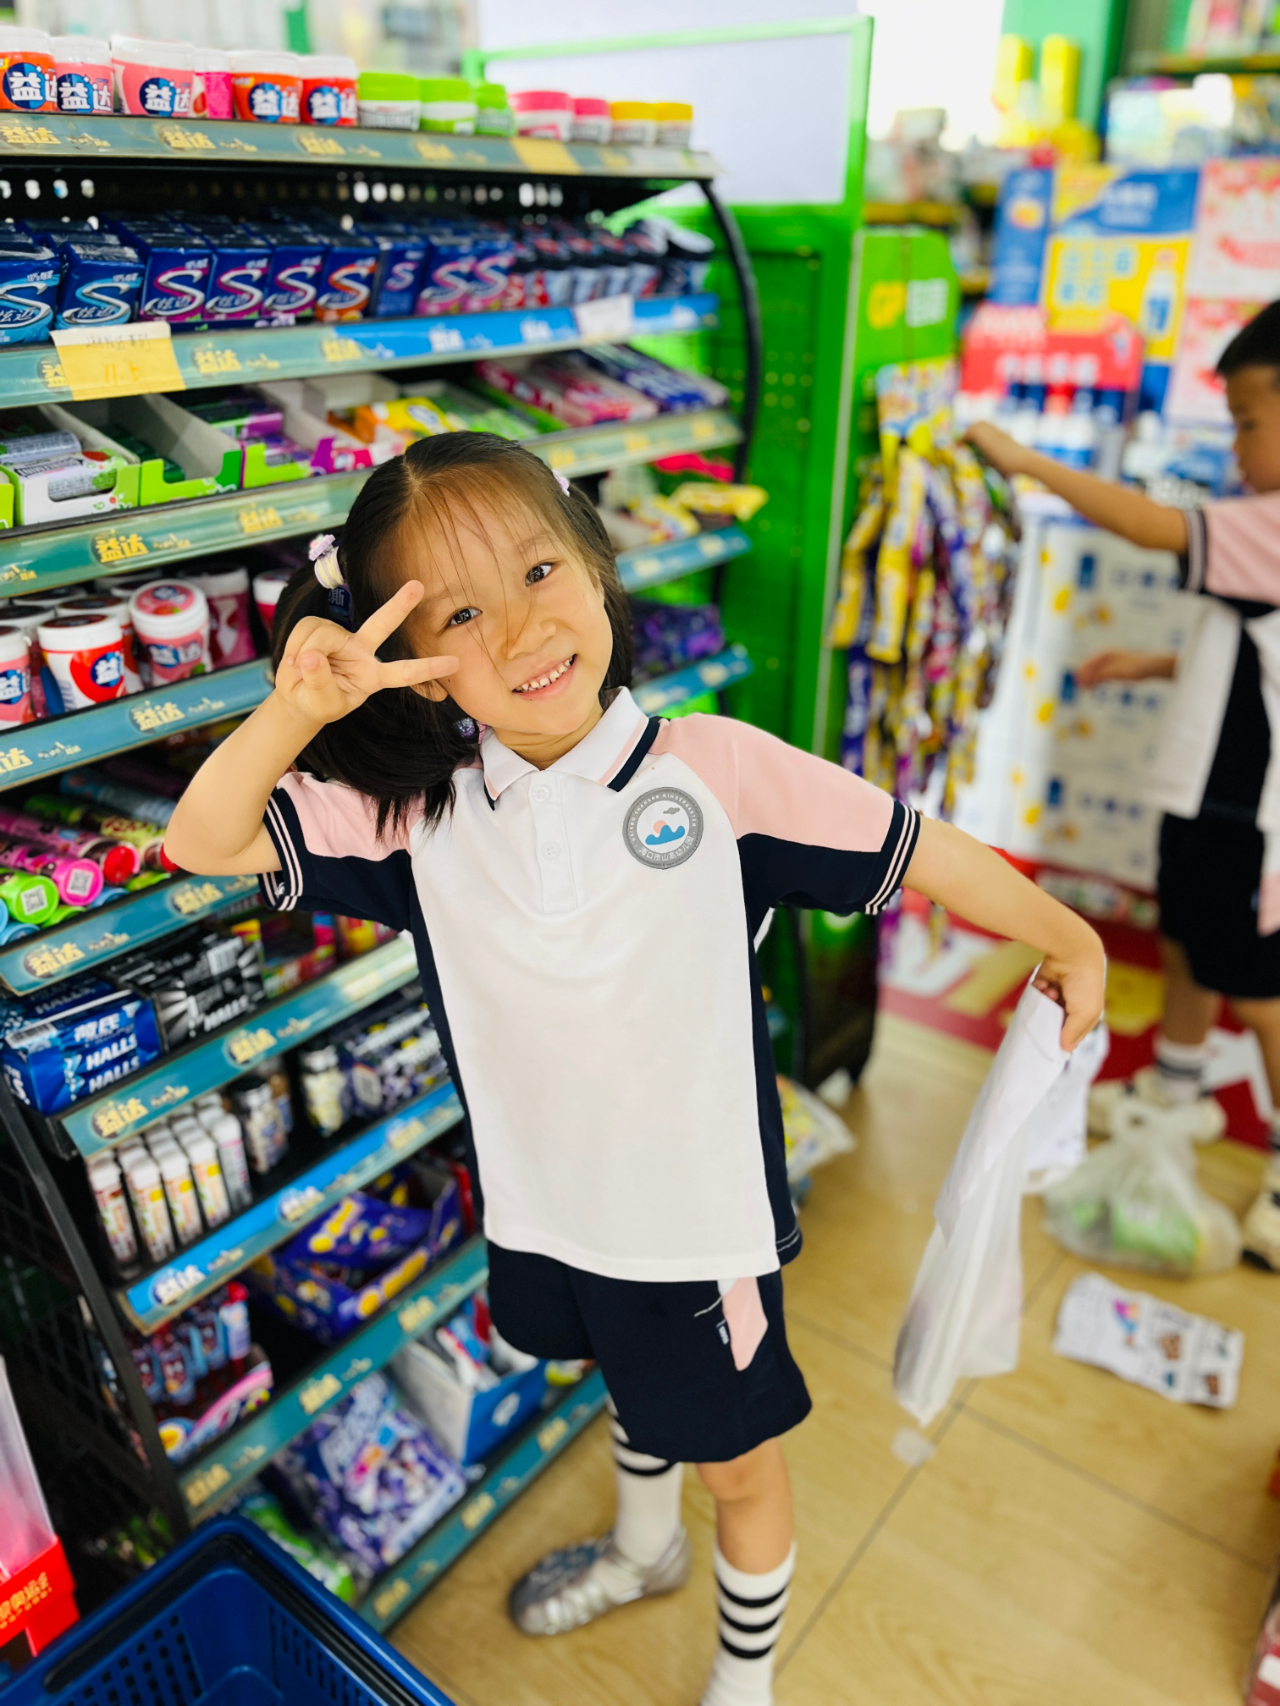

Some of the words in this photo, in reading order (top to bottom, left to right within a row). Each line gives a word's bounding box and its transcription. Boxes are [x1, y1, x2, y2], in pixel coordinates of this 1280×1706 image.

[59, 81, 112, 112] 益达
[145, 84, 191, 112] 益达
[251, 88, 299, 117] 益达
[1, 125, 61, 146] 益达
[163, 130, 216, 151] 益达
[77, 306, 115, 319] 炫迈
[197, 346, 241, 373] 益达
[97, 532, 148, 563] 益达
[95, 657, 124, 684] 益
[134, 702, 185, 731] 益达
[662, 793, 697, 827] KINDERGARTEN
[29, 942, 85, 977] 益达
[86, 1033, 138, 1071] HALLS
[88, 1055, 140, 1094] HALLS
[98, 1098, 148, 1138] 益达
